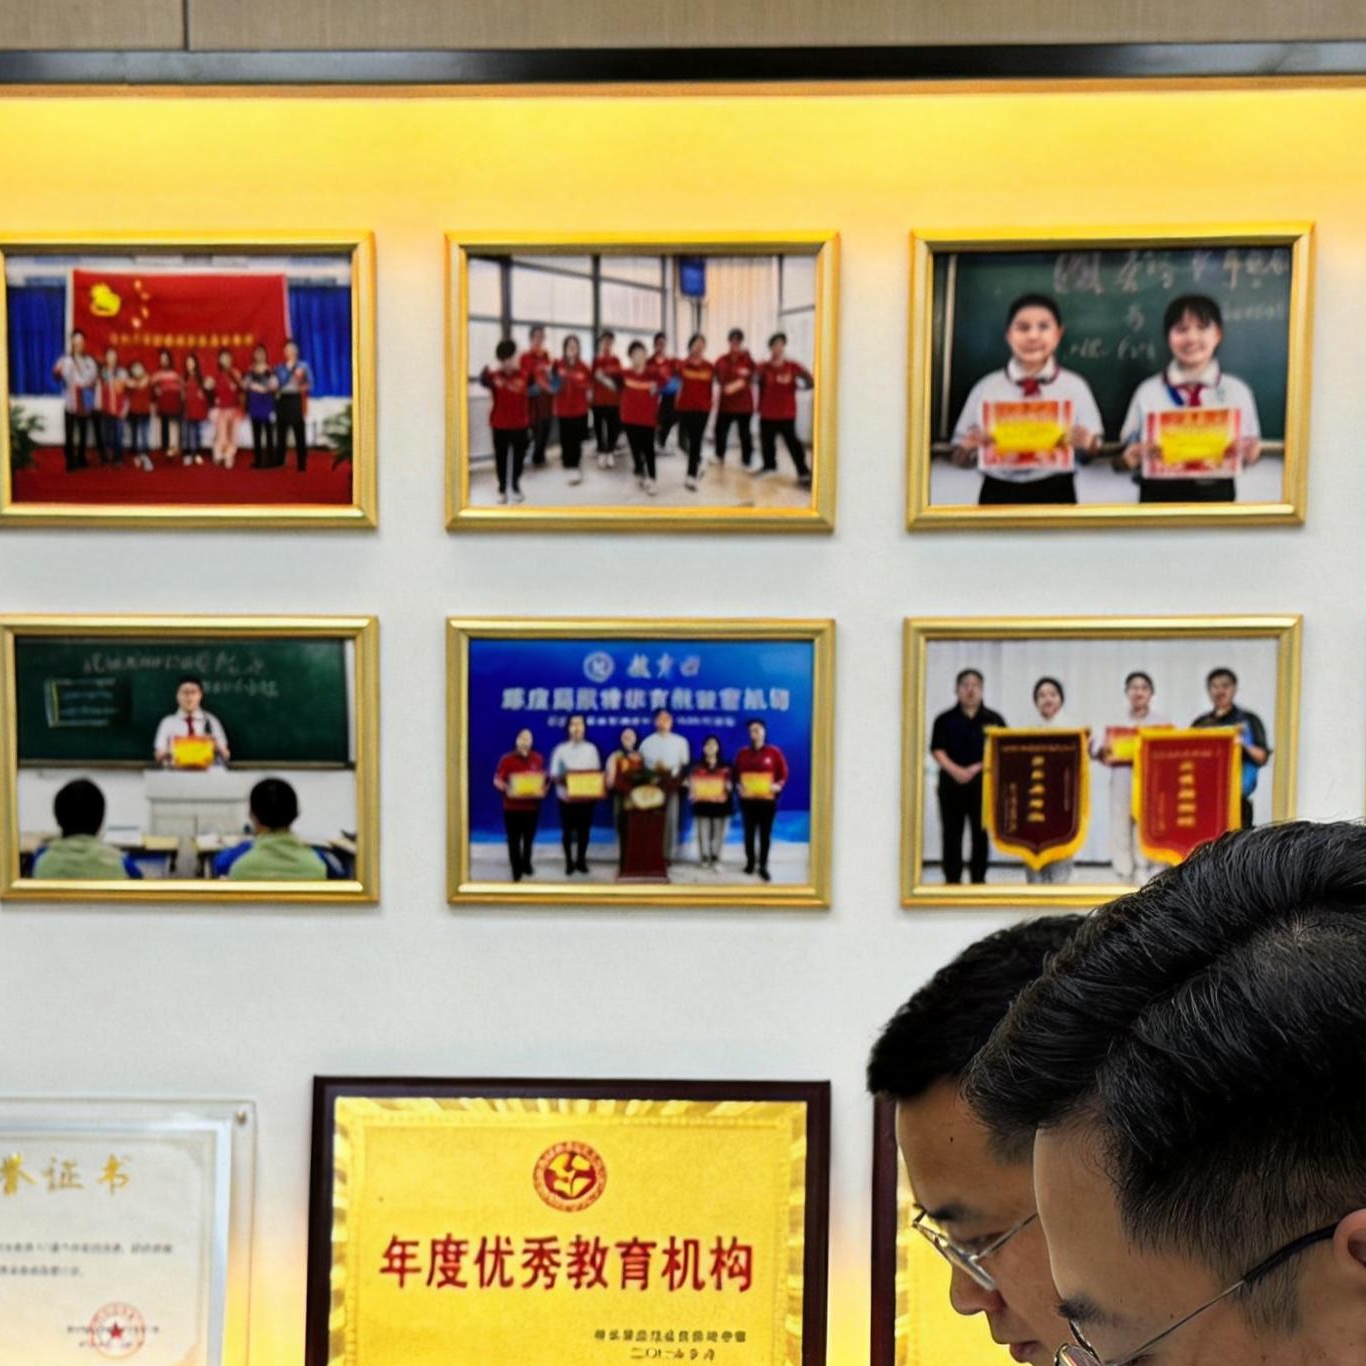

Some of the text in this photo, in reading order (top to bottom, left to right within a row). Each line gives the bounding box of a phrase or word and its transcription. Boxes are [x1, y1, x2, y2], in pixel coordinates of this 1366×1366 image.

[379, 1232, 755, 1294] 年度优秀教育机构
